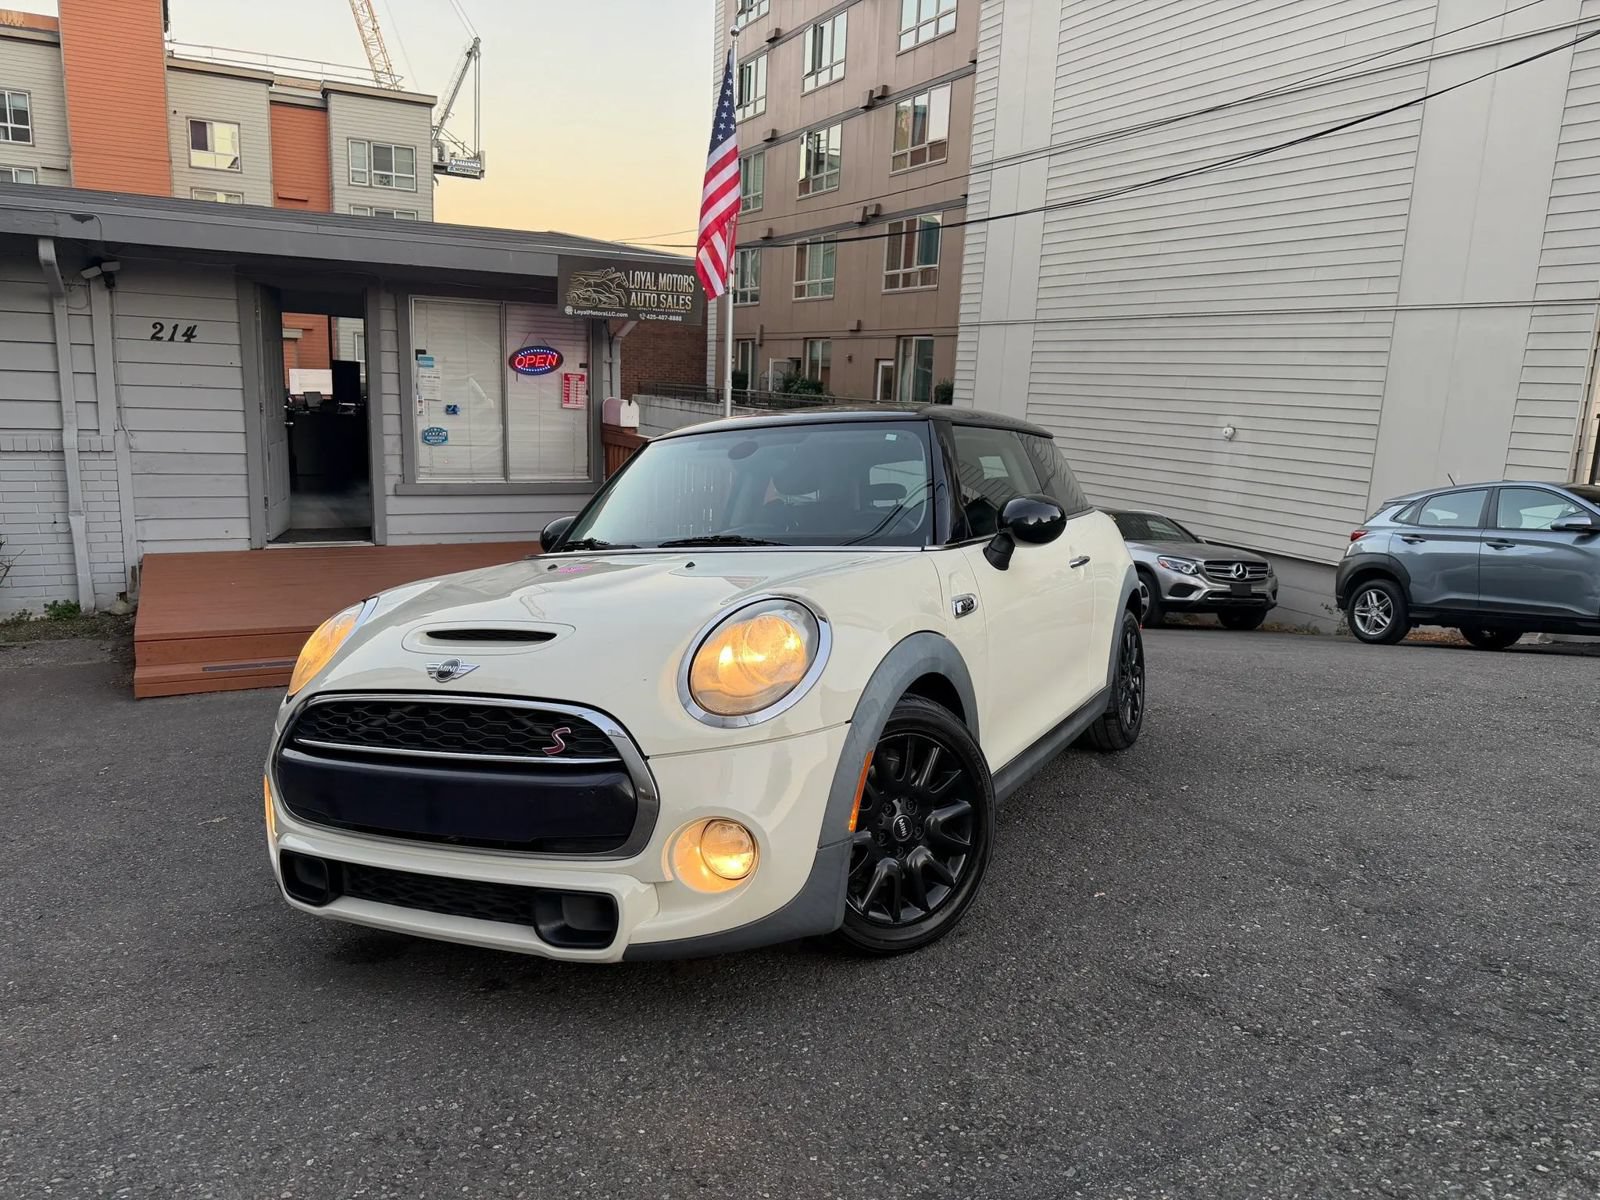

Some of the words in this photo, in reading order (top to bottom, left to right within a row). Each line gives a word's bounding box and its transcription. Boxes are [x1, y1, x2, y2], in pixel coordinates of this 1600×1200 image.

[629, 270, 657, 289] LOYAL
[659, 273, 695, 293] MOTORS
[630, 292, 658, 307] AUTO
[660, 294, 692, 310] SALES
[574, 308, 628, 318] LoyalMotorsLLC.com
[150, 321, 197, 343] 214
[514, 354, 558, 368] OPEN
[541, 726, 572, 755] S
[898, 818, 908, 837] MINI
